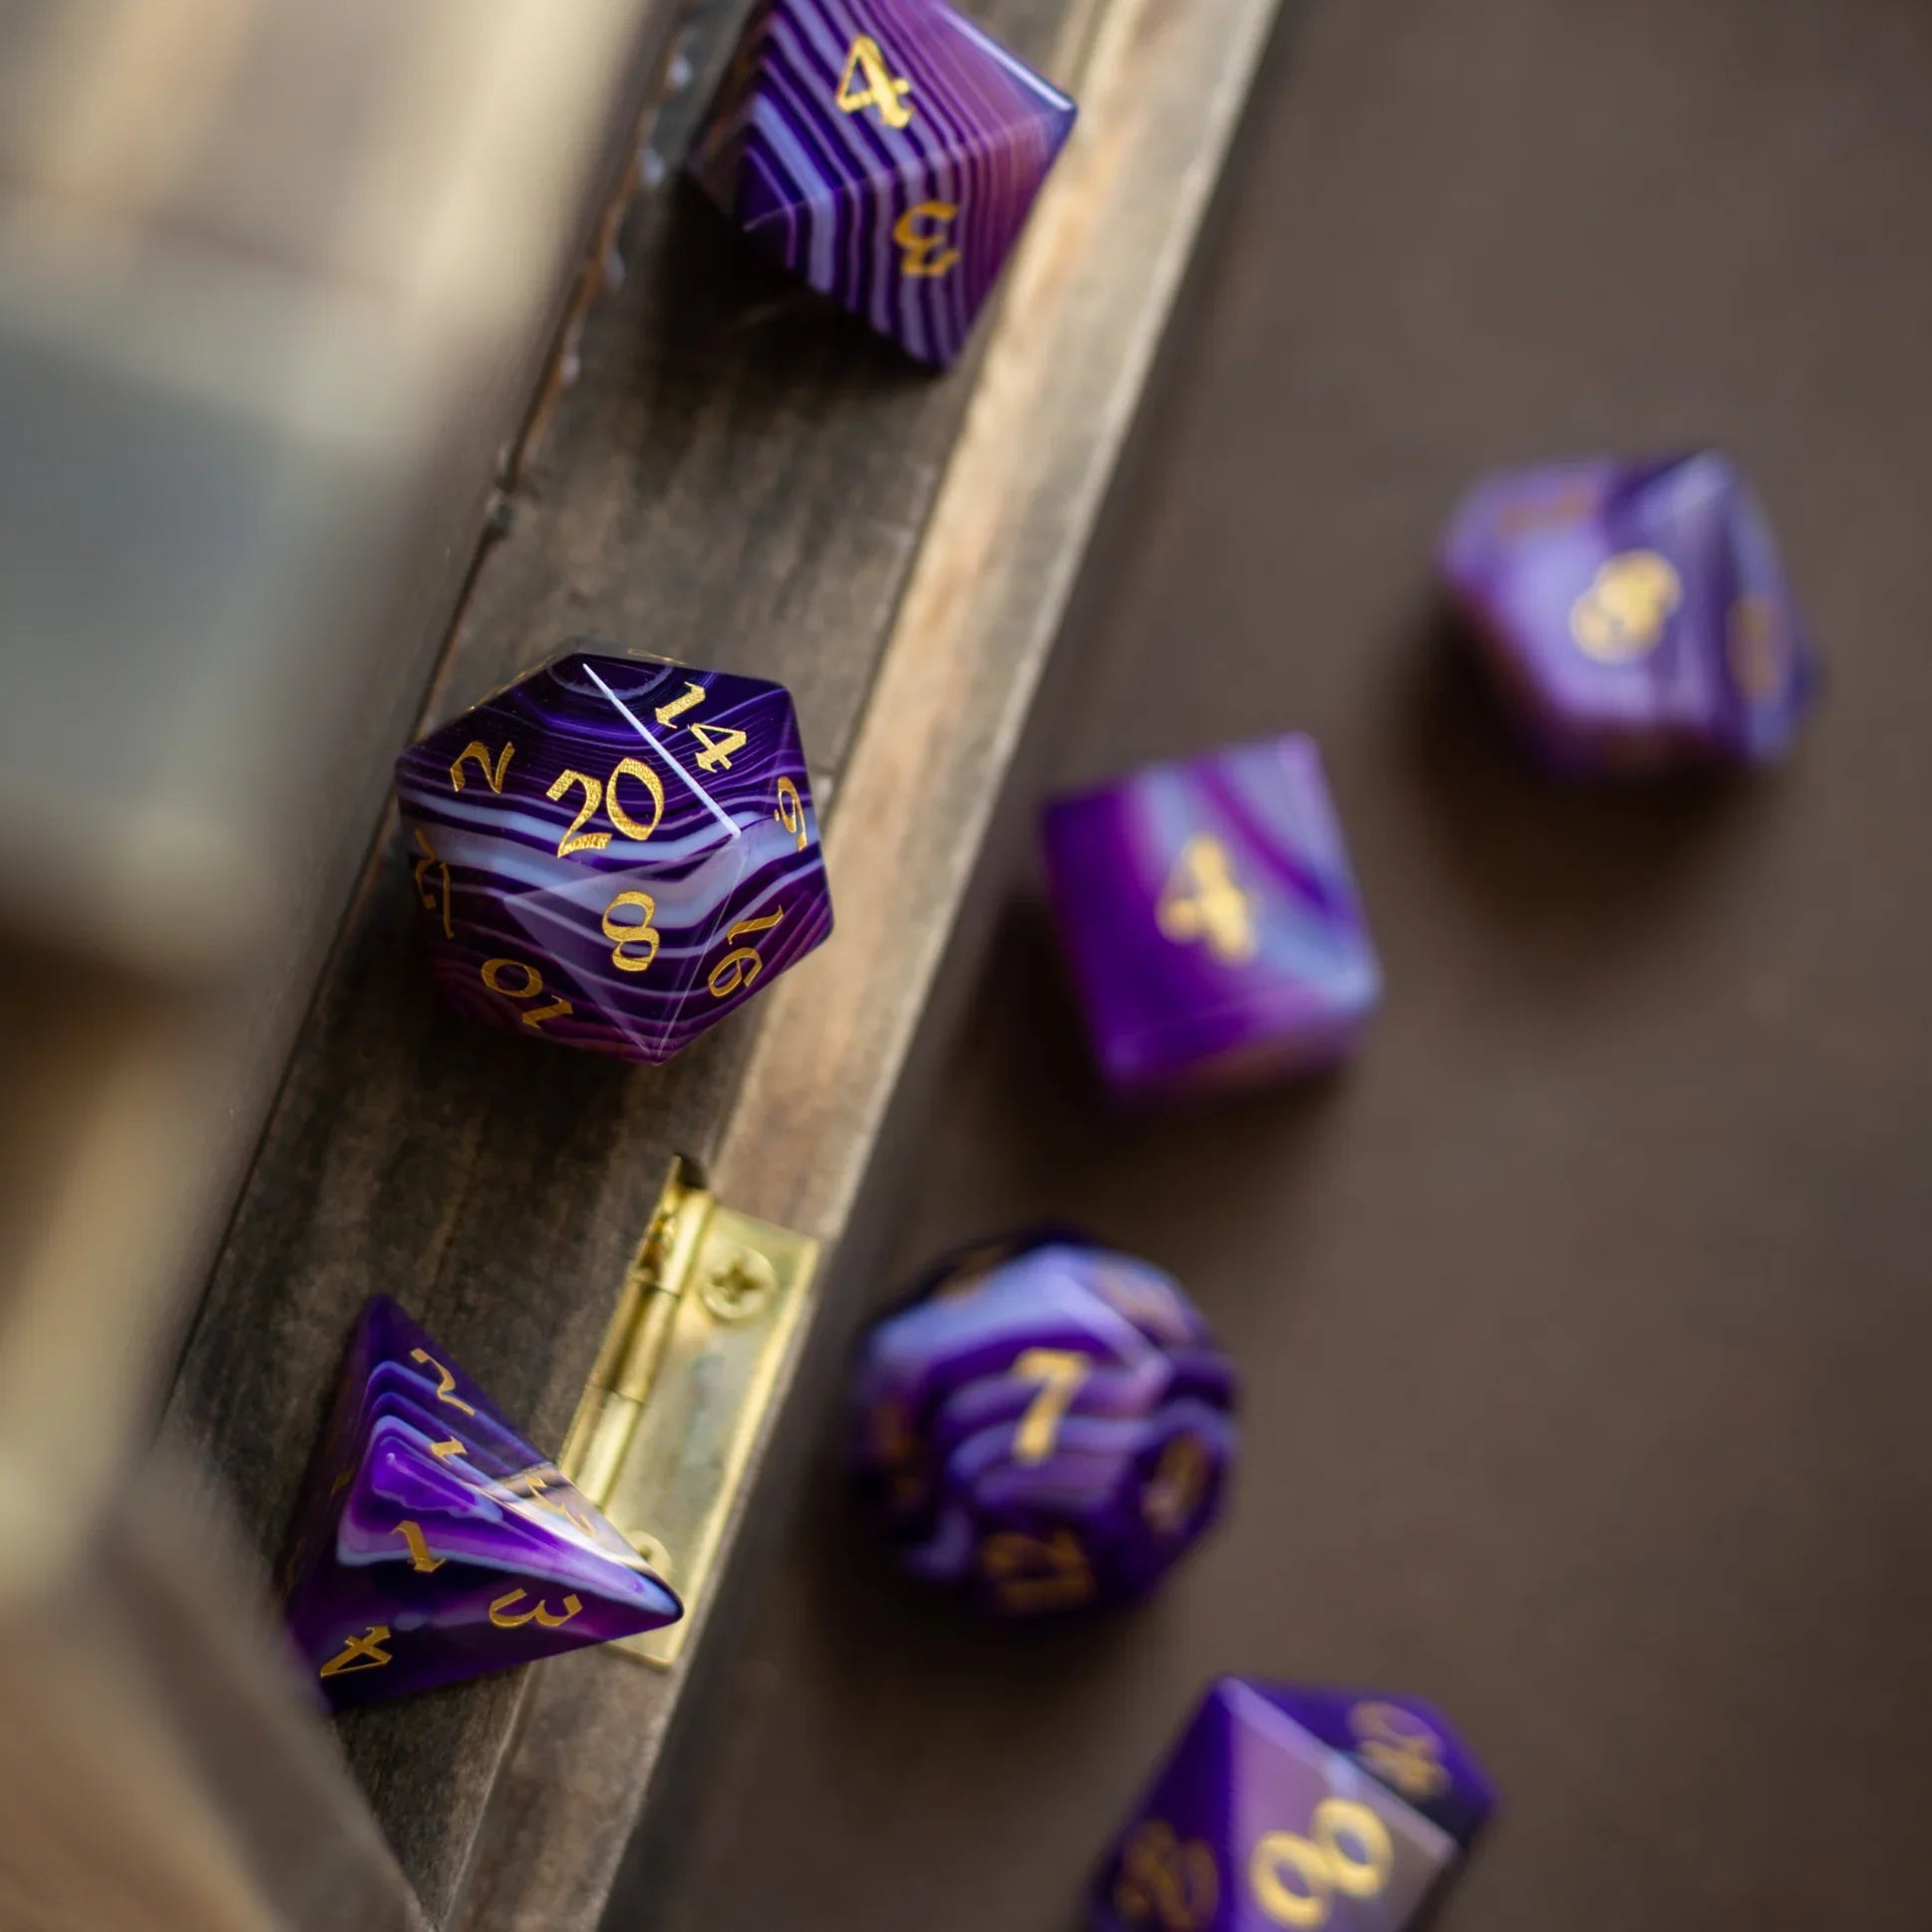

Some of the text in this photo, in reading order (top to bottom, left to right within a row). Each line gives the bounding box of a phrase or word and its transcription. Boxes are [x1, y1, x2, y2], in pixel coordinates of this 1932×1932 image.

[835, 35, 914, 129] 4
[893, 200, 960, 277] 3
[654, 681, 748, 773] 14
[450, 742, 515, 794] 2
[545, 758, 665, 858] 20
[602, 891, 660, 973] 8
[1156, 833, 1260, 967] 4
[708, 904, 785, 998] 16
[481, 958, 574, 1029] 10
[410, 1348, 476, 1416] 2
[1011, 1347, 1091, 1466] 7
[430, 1436, 468, 1465] 1
[391, 1520, 447, 1574] 1
[487, 1588, 583, 1629] 3
[320, 1625, 394, 1678] 4
